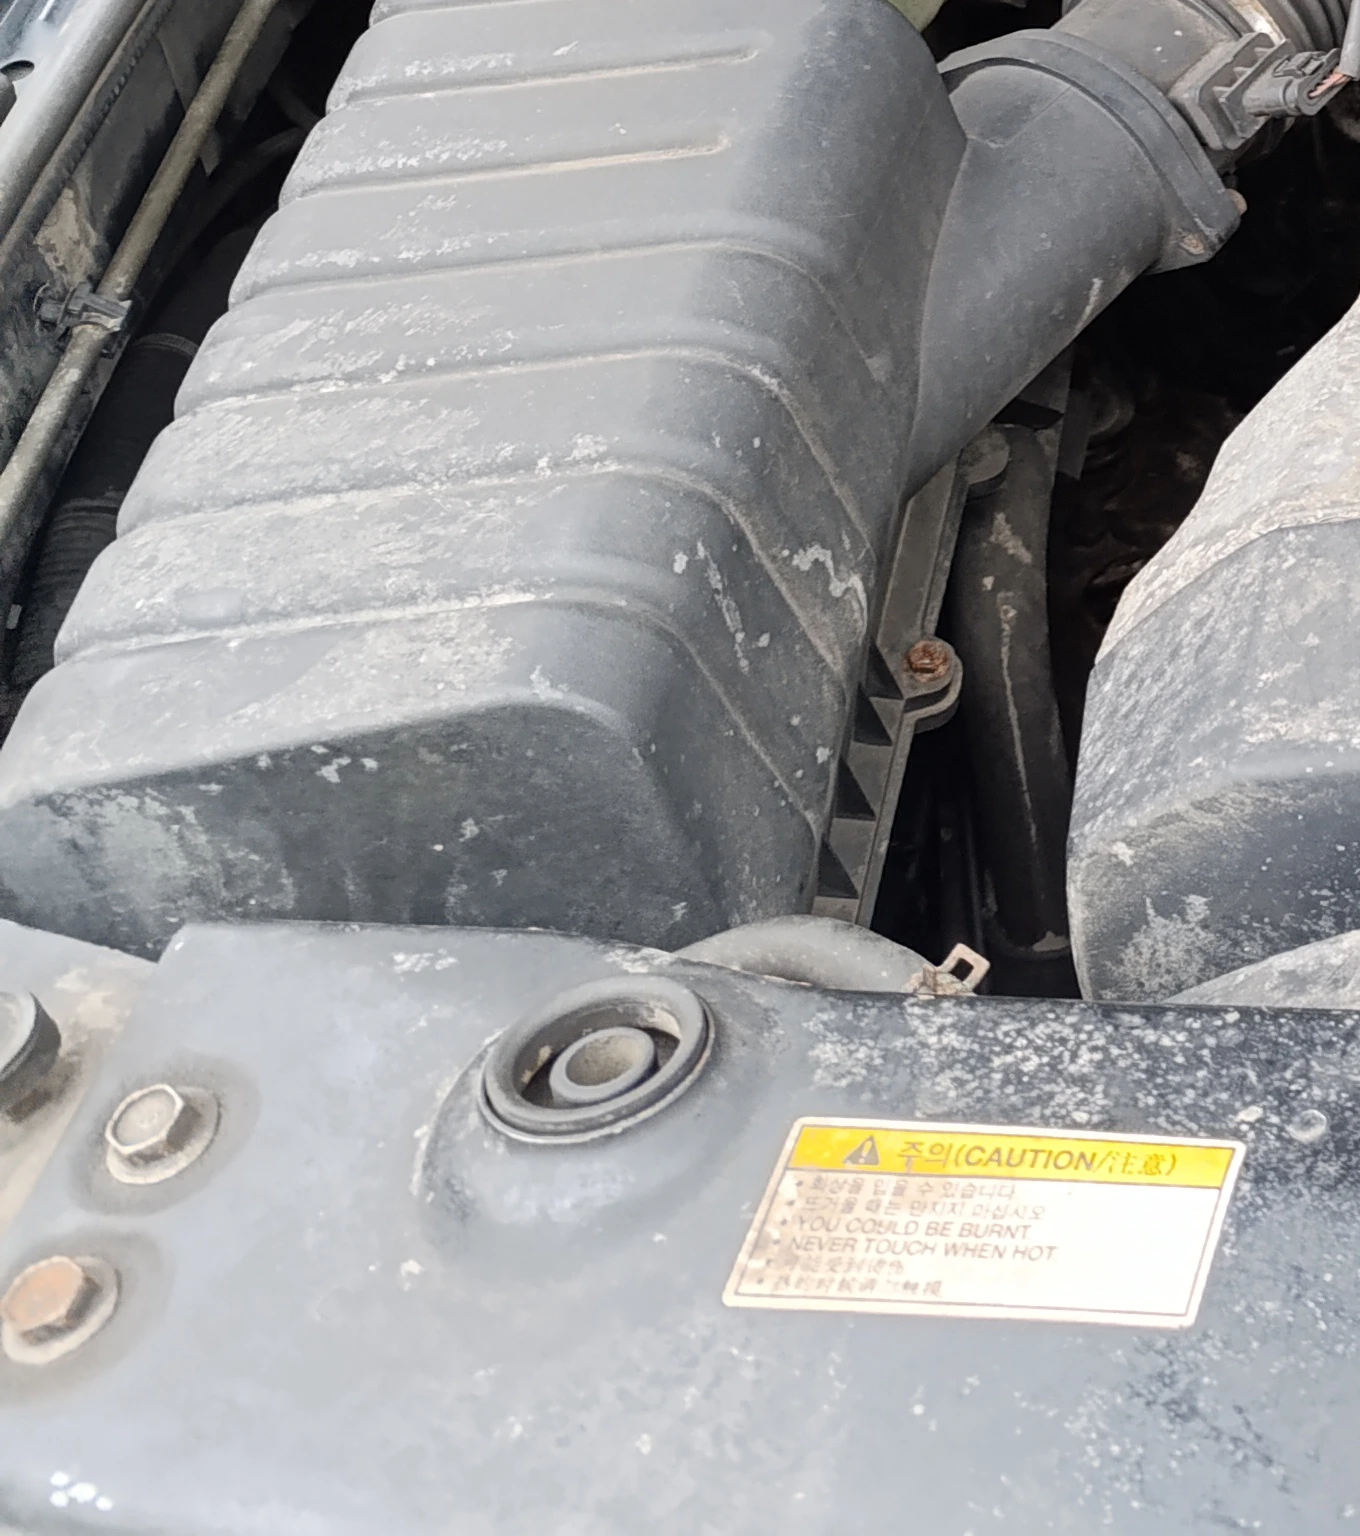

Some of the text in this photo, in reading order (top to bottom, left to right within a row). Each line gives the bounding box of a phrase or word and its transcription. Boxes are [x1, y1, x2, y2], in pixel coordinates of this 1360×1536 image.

[796, 1215, 840, 1234] YOU
[924, 1219, 955, 1238] BE
[957, 1221, 1033, 1241] BURNT
[791, 1235, 1058, 1262] NEVER TOUCH WHEN HOT
